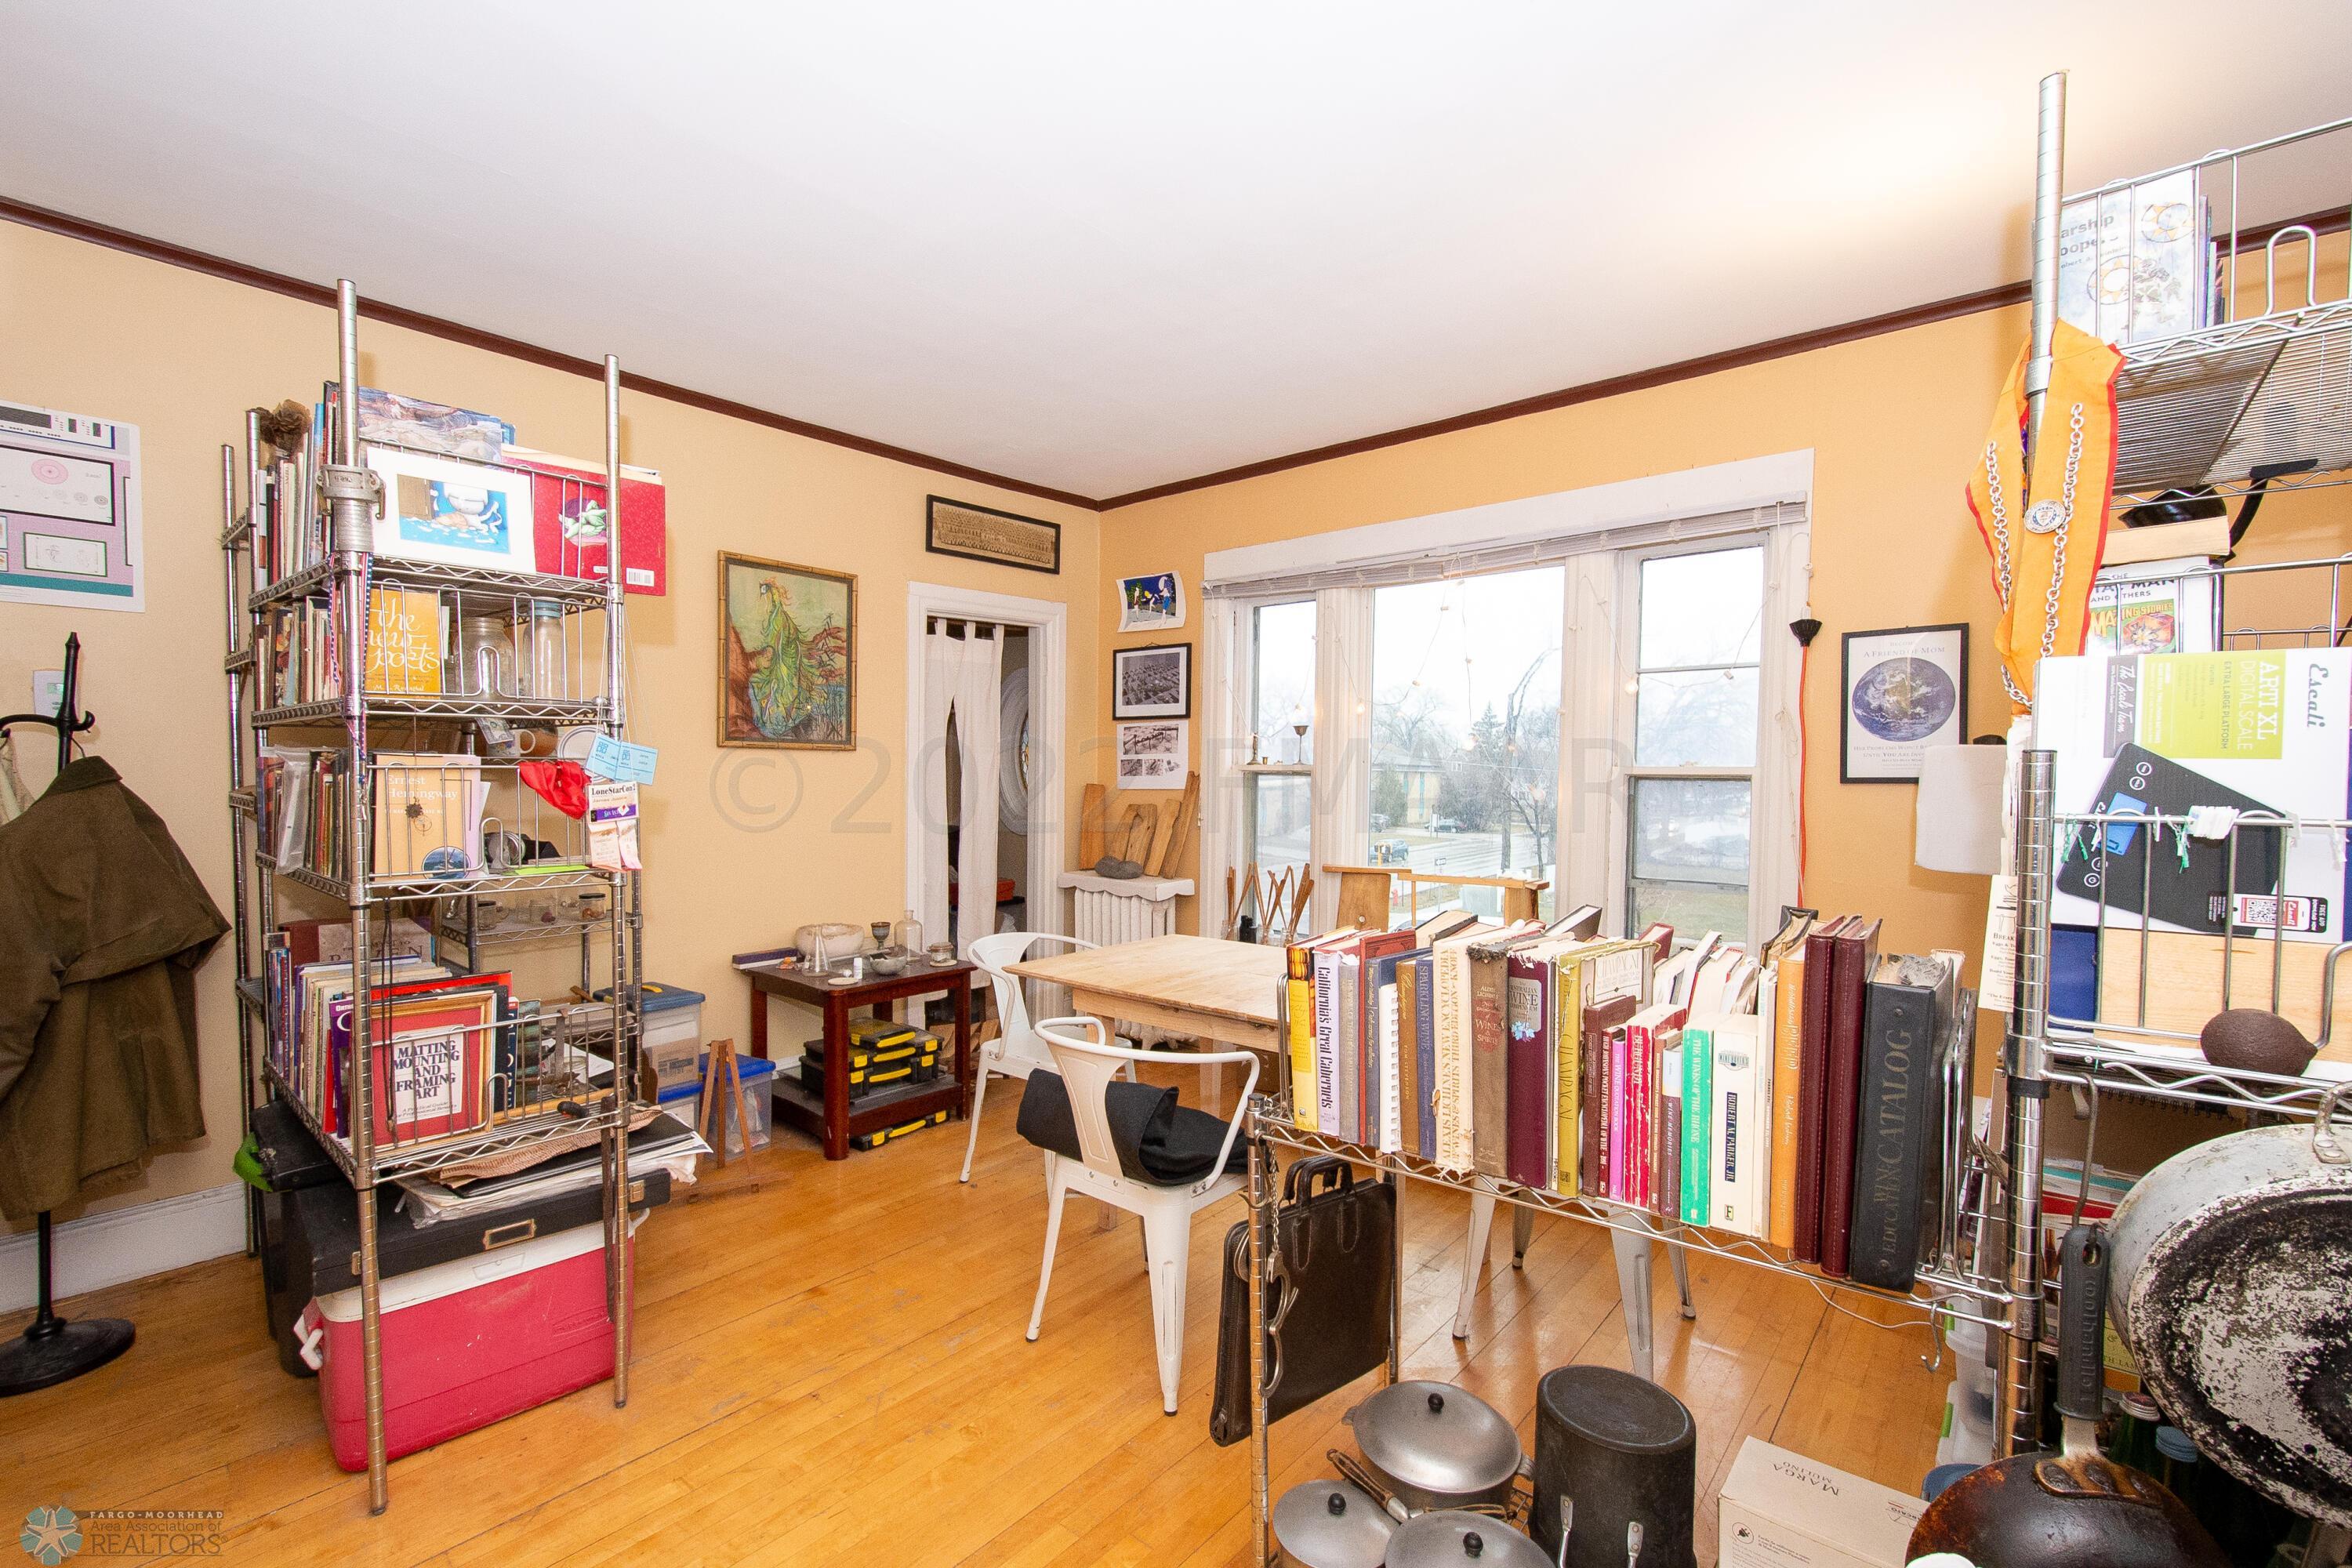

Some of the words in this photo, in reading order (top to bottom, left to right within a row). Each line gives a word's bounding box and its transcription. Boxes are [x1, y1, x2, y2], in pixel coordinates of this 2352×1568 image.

[2060, 215, 2114, 238] arship
[368, 597, 423, 632] the
[2140, 601, 2173, 616] STORIES
[2119, 665, 2136, 680] The
[2223, 661, 2232, 684] EXTRA
[2238, 660, 2256, 708] DIGITAL
[2258, 661, 2281, 707] ARTI
[2117, 682, 2134, 709] Escali
[2222, 685, 2231, 710] LARGE
[2307, 663, 2330, 728] Escali
[2117, 710, 2133, 733] Team
[2220, 711, 2230, 749] PLATFORM
[2238, 711, 2255, 750] SCALE
[2257, 712, 2278, 740] XL
[1318, 967, 1332, 1023] California's
[1399, 973, 1412, 1020] Champagne
[1418, 966, 1429, 1021] SPARKLING
[1440, 949, 1450, 1031] ENCYCLOPEDIA
[1510, 990, 1538, 1007] WINE
[1420, 1022, 1430, 1050] WINE
[1475, 1019, 1501, 1031] WINES
[397, 1040, 456, 1059] MATTING
[1319, 1026, 1332, 1054] Great
[1441, 1033, 1450, 1060] NEW
[1450, 1031, 1459, 1062] THIRD
[1693, 1040, 1701, 1055] THE
[393, 1051, 460, 1070] MOUNTING
[414, 1064, 441, 1078] AND
[1693, 1058, 1701, 1084] WINES
[395, 1073, 456, 1092] FRAMING
[416, 1085, 440, 1099] ART
[1319, 1056, 1334, 1109] Cabernets
[1601, 1075, 1610, 1094] POCKET
[1692, 1084, 1700, 1094] OF
[1692, 1095, 1700, 1113] THE
[1726, 1094, 1737, 1124] ROBERT
[1877, 1029, 1911, 1164] CATALOG
[1600, 1094, 1609, 1129] ENCYCLOPEDIA
[1442, 1119, 1452, 1160] ALEXIS
[1451, 1115, 1460, 1149] WINES
[1773, 1464, 1839, 1496] MARGA
[1783, 1461, 1832, 1483] MULINO
